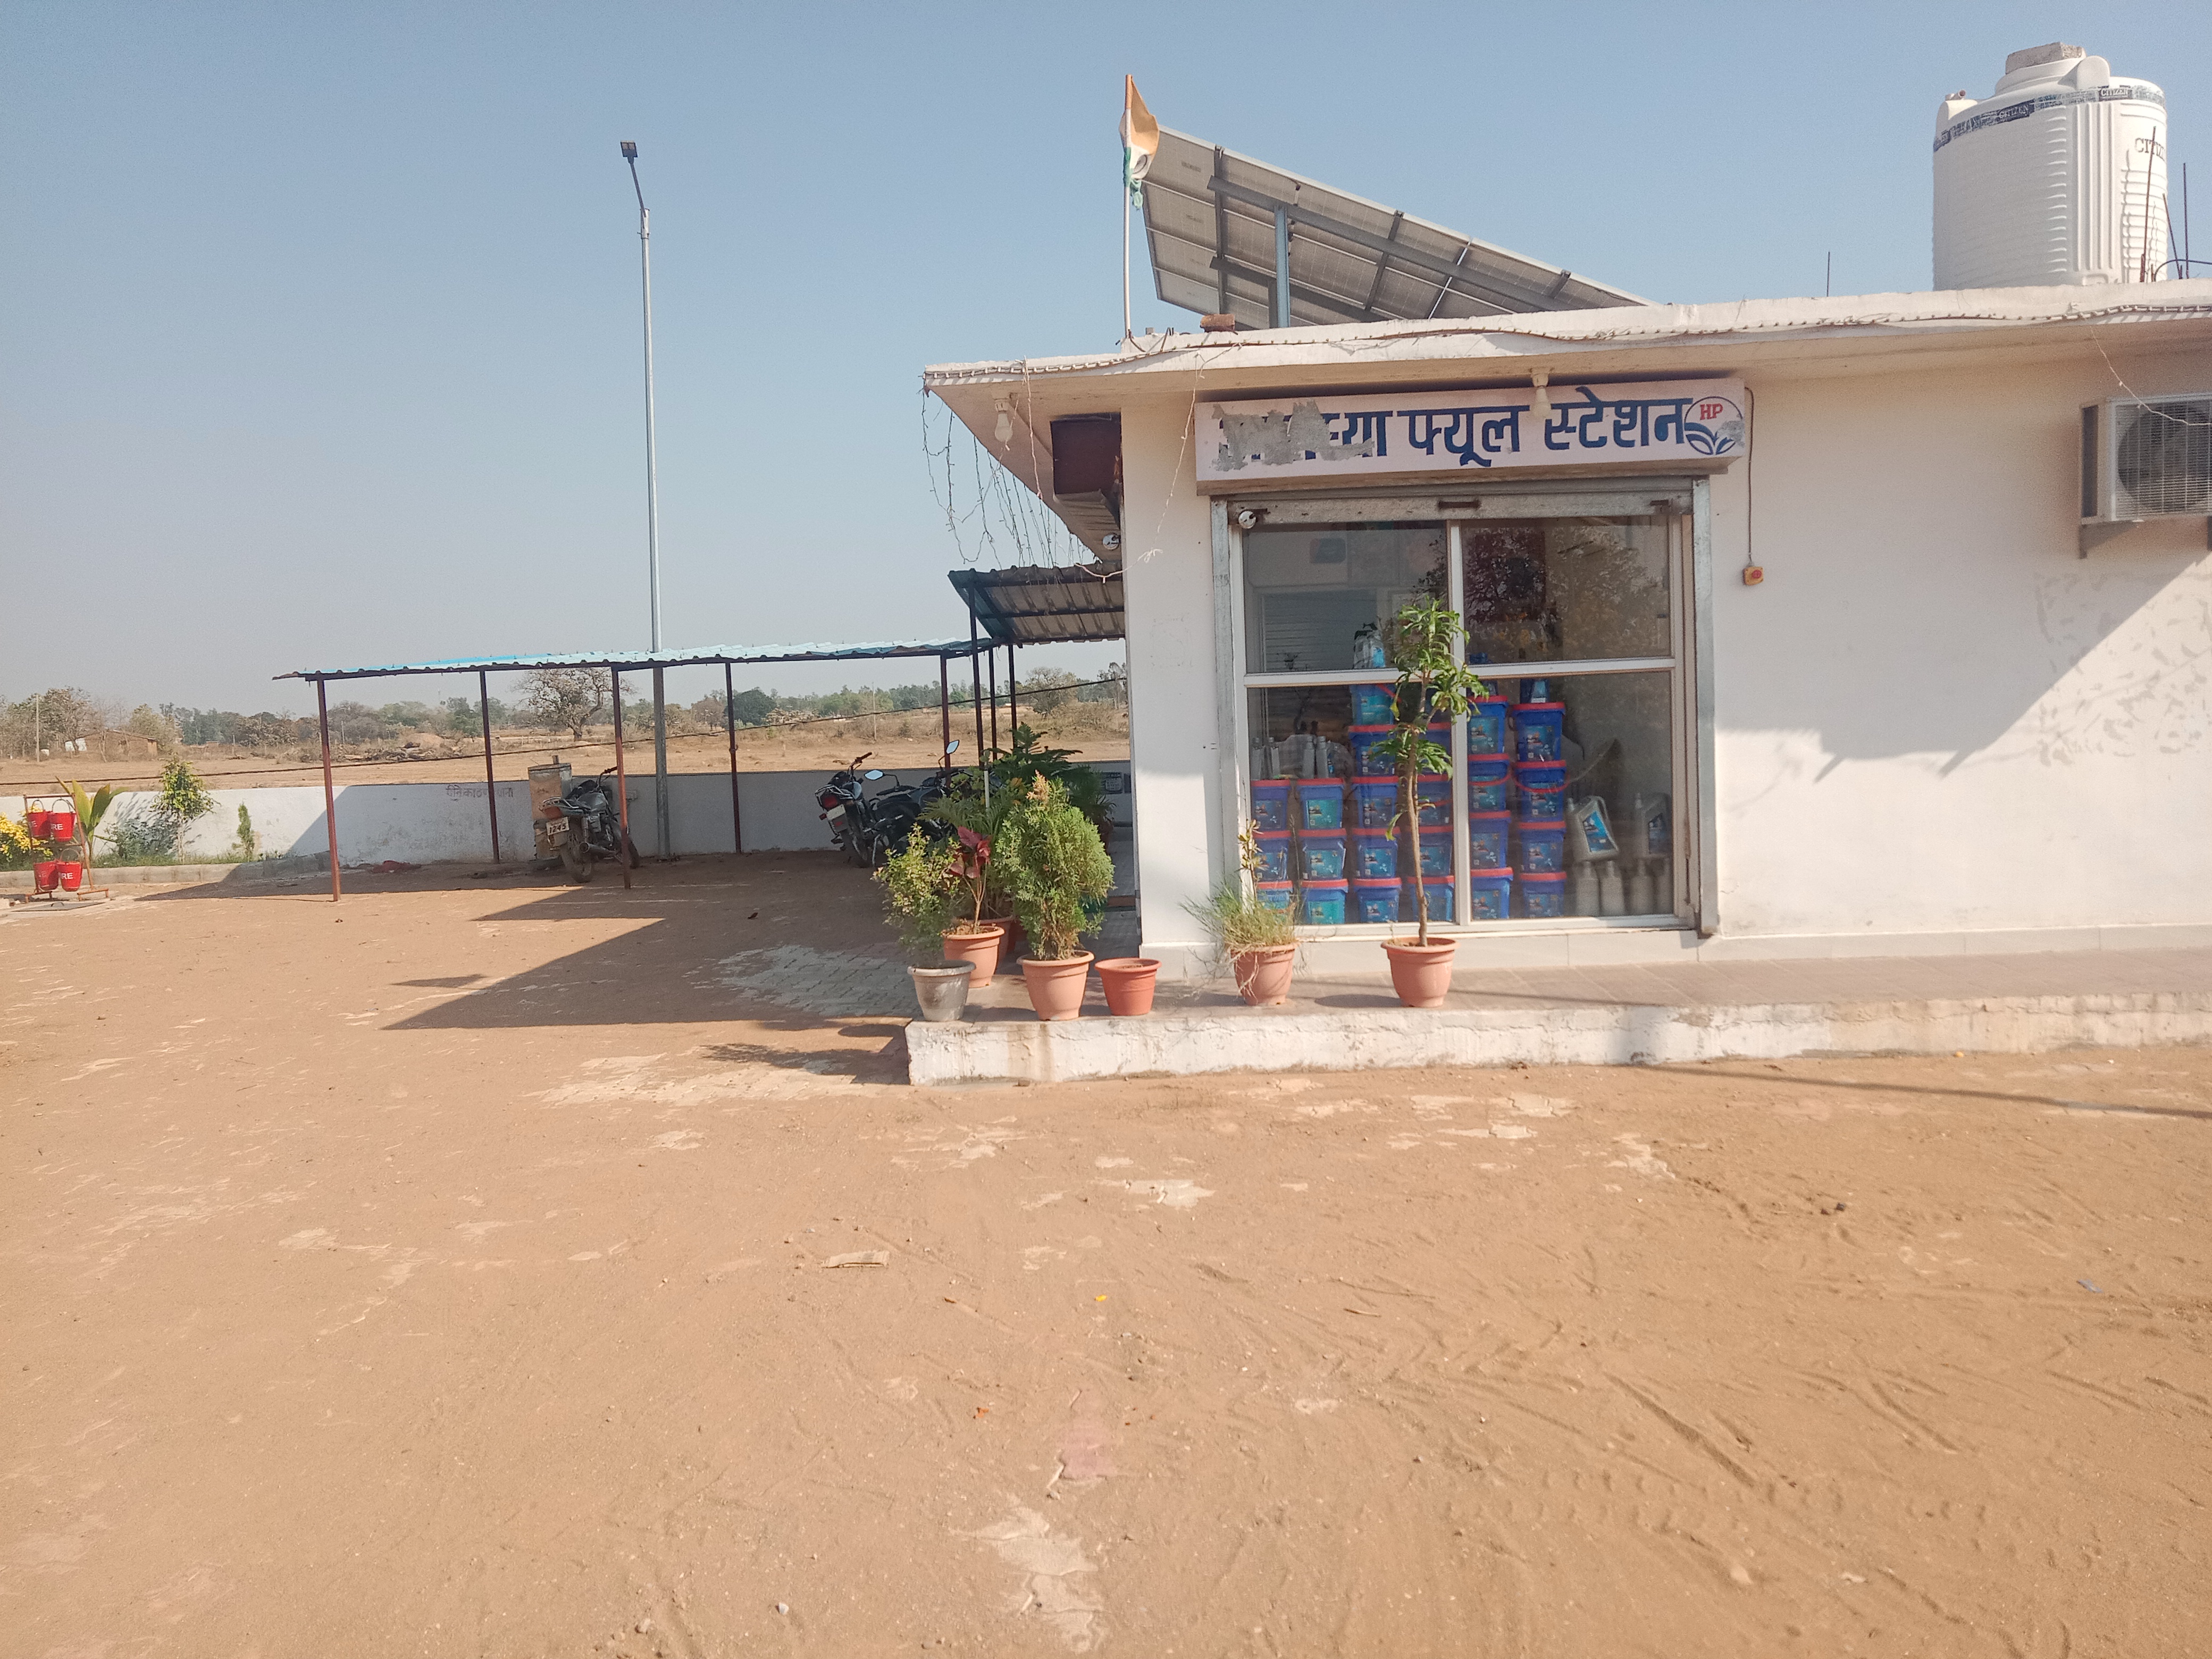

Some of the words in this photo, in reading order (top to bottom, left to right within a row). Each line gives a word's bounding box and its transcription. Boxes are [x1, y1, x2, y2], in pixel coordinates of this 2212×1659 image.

[2134, 137, 2167, 162] CITIZ
[1700, 403, 1723, 420] HP
[1397, 405, 1530, 467] फ्यूल
[1544, 386, 1693, 450] स्टेशन
